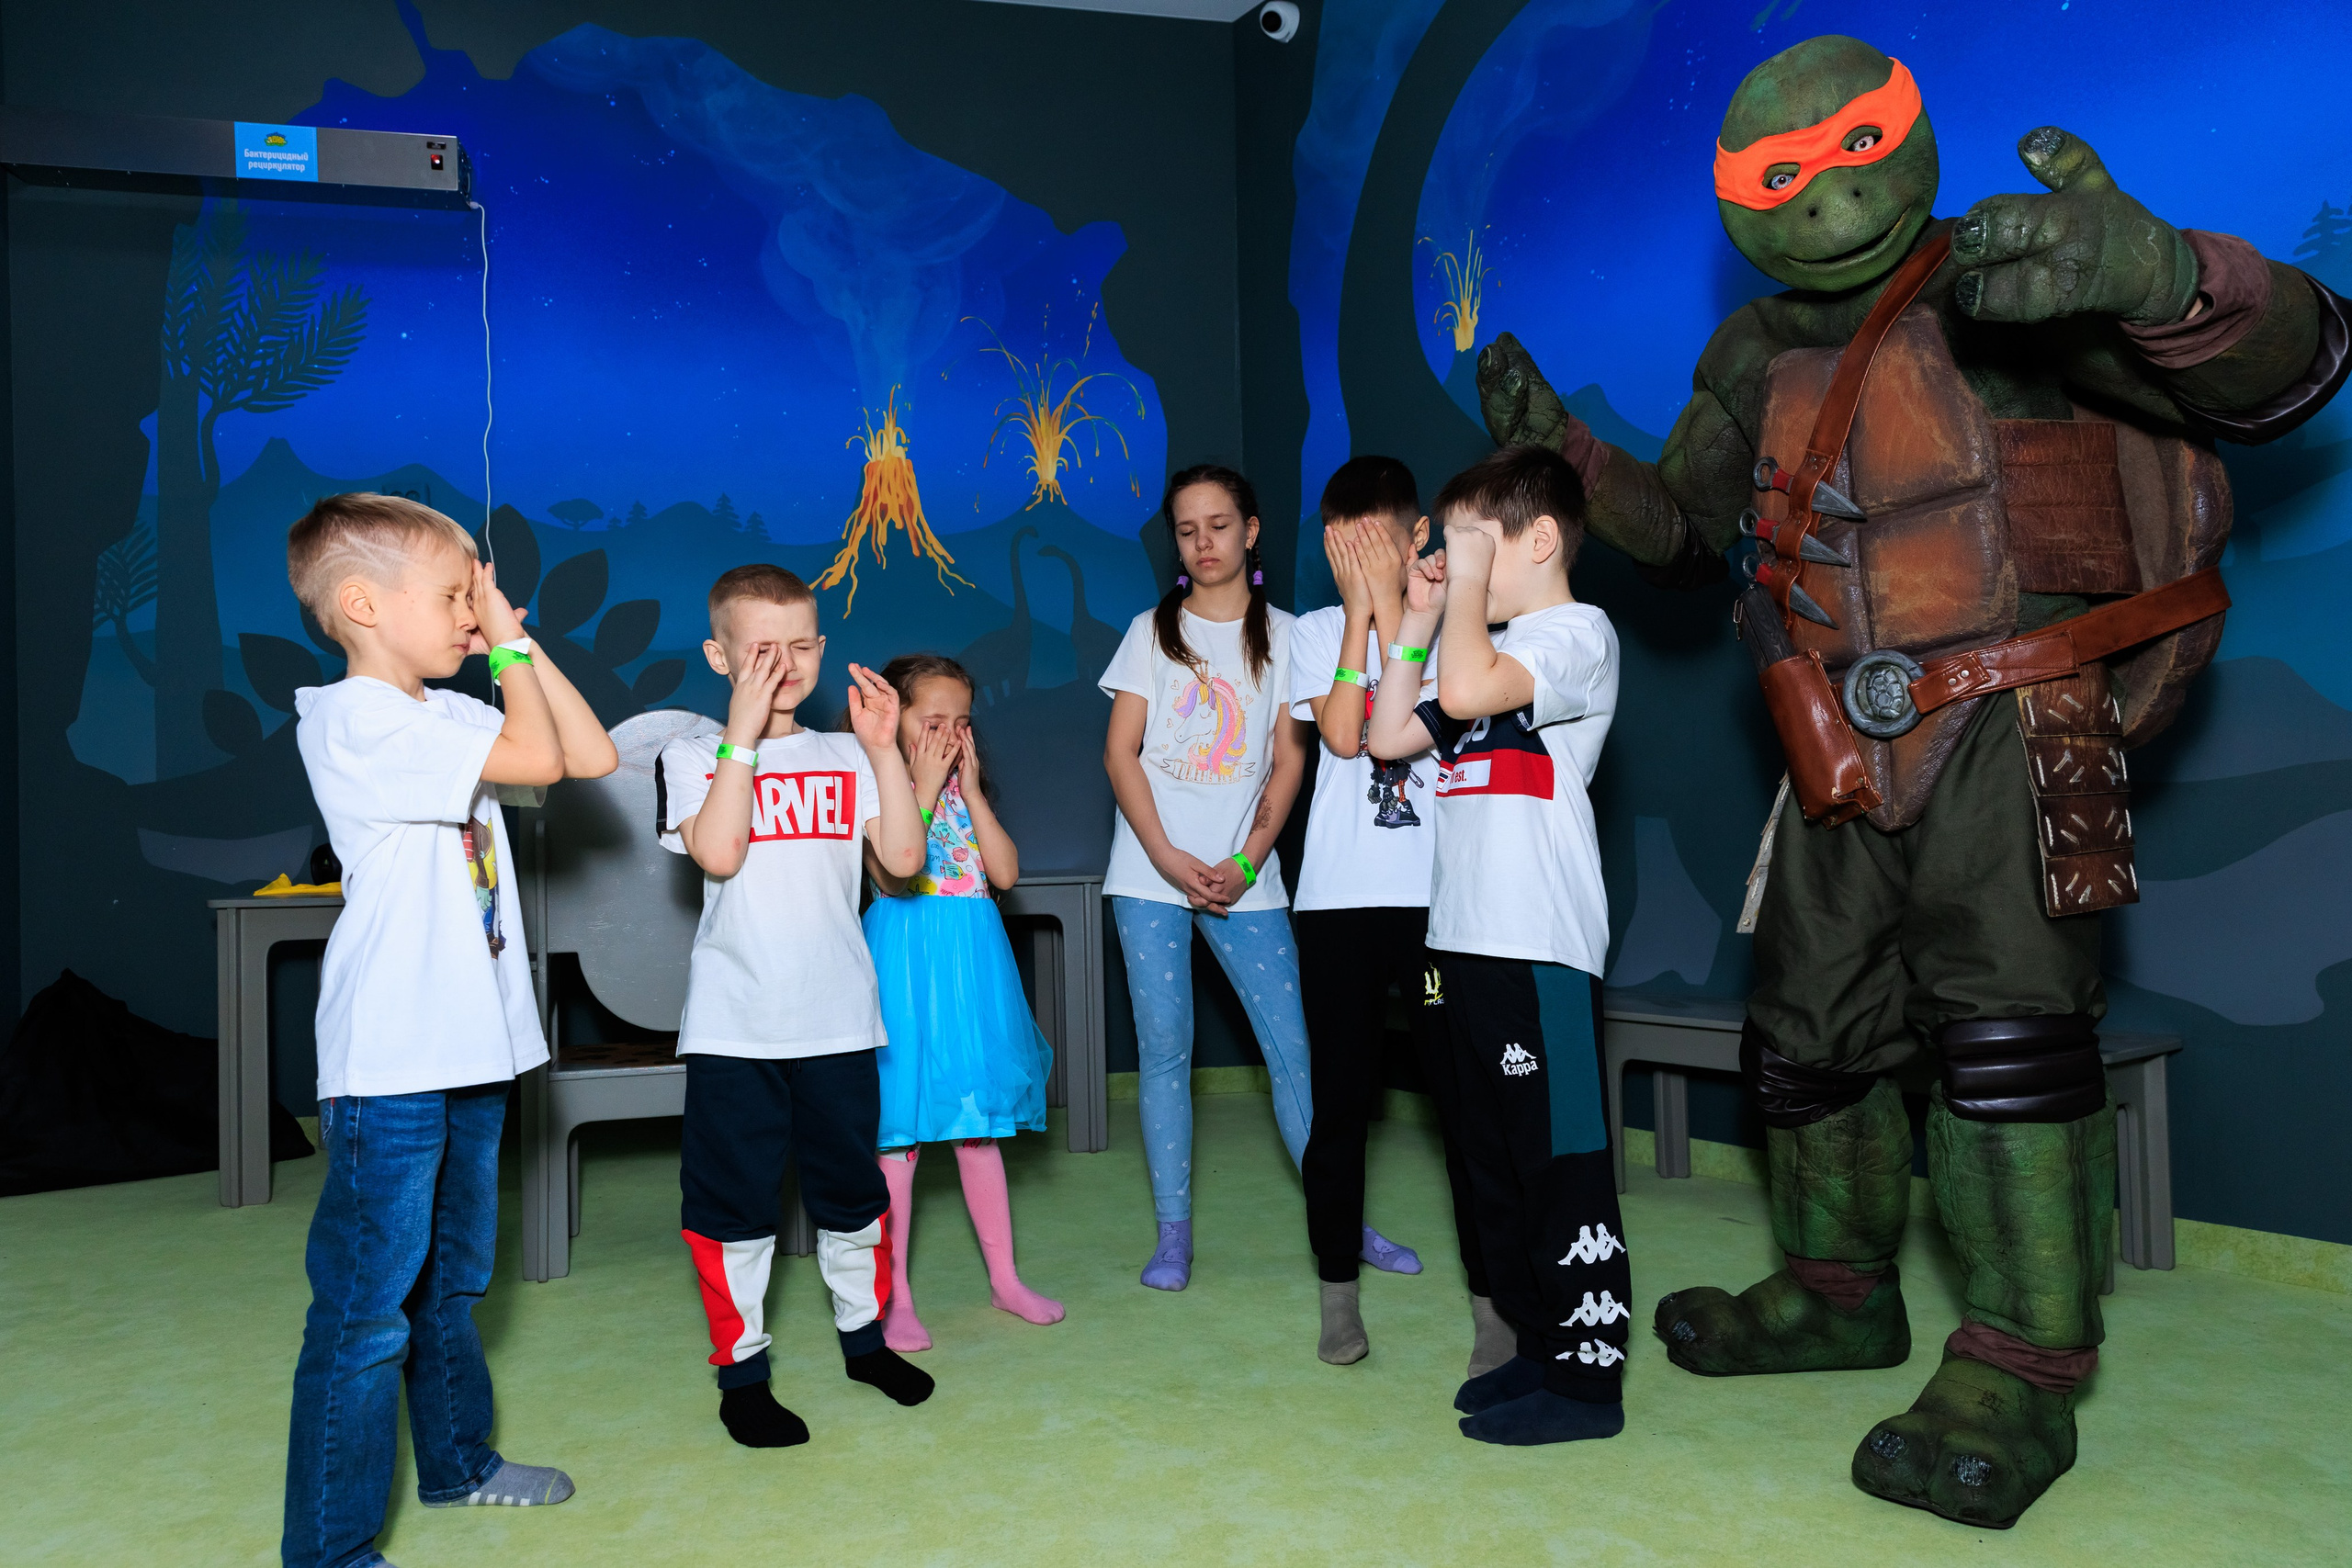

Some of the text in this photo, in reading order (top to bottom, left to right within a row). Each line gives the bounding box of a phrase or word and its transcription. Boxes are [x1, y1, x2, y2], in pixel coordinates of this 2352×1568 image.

[243, 148, 309, 161] Бактерицидный
[248, 161, 306, 173] рециркулятор
[1454, 769, 1467, 784] est.
[752, 775, 850, 837] ARVEL
[1501, 1060, 1539, 1077] Kappa
